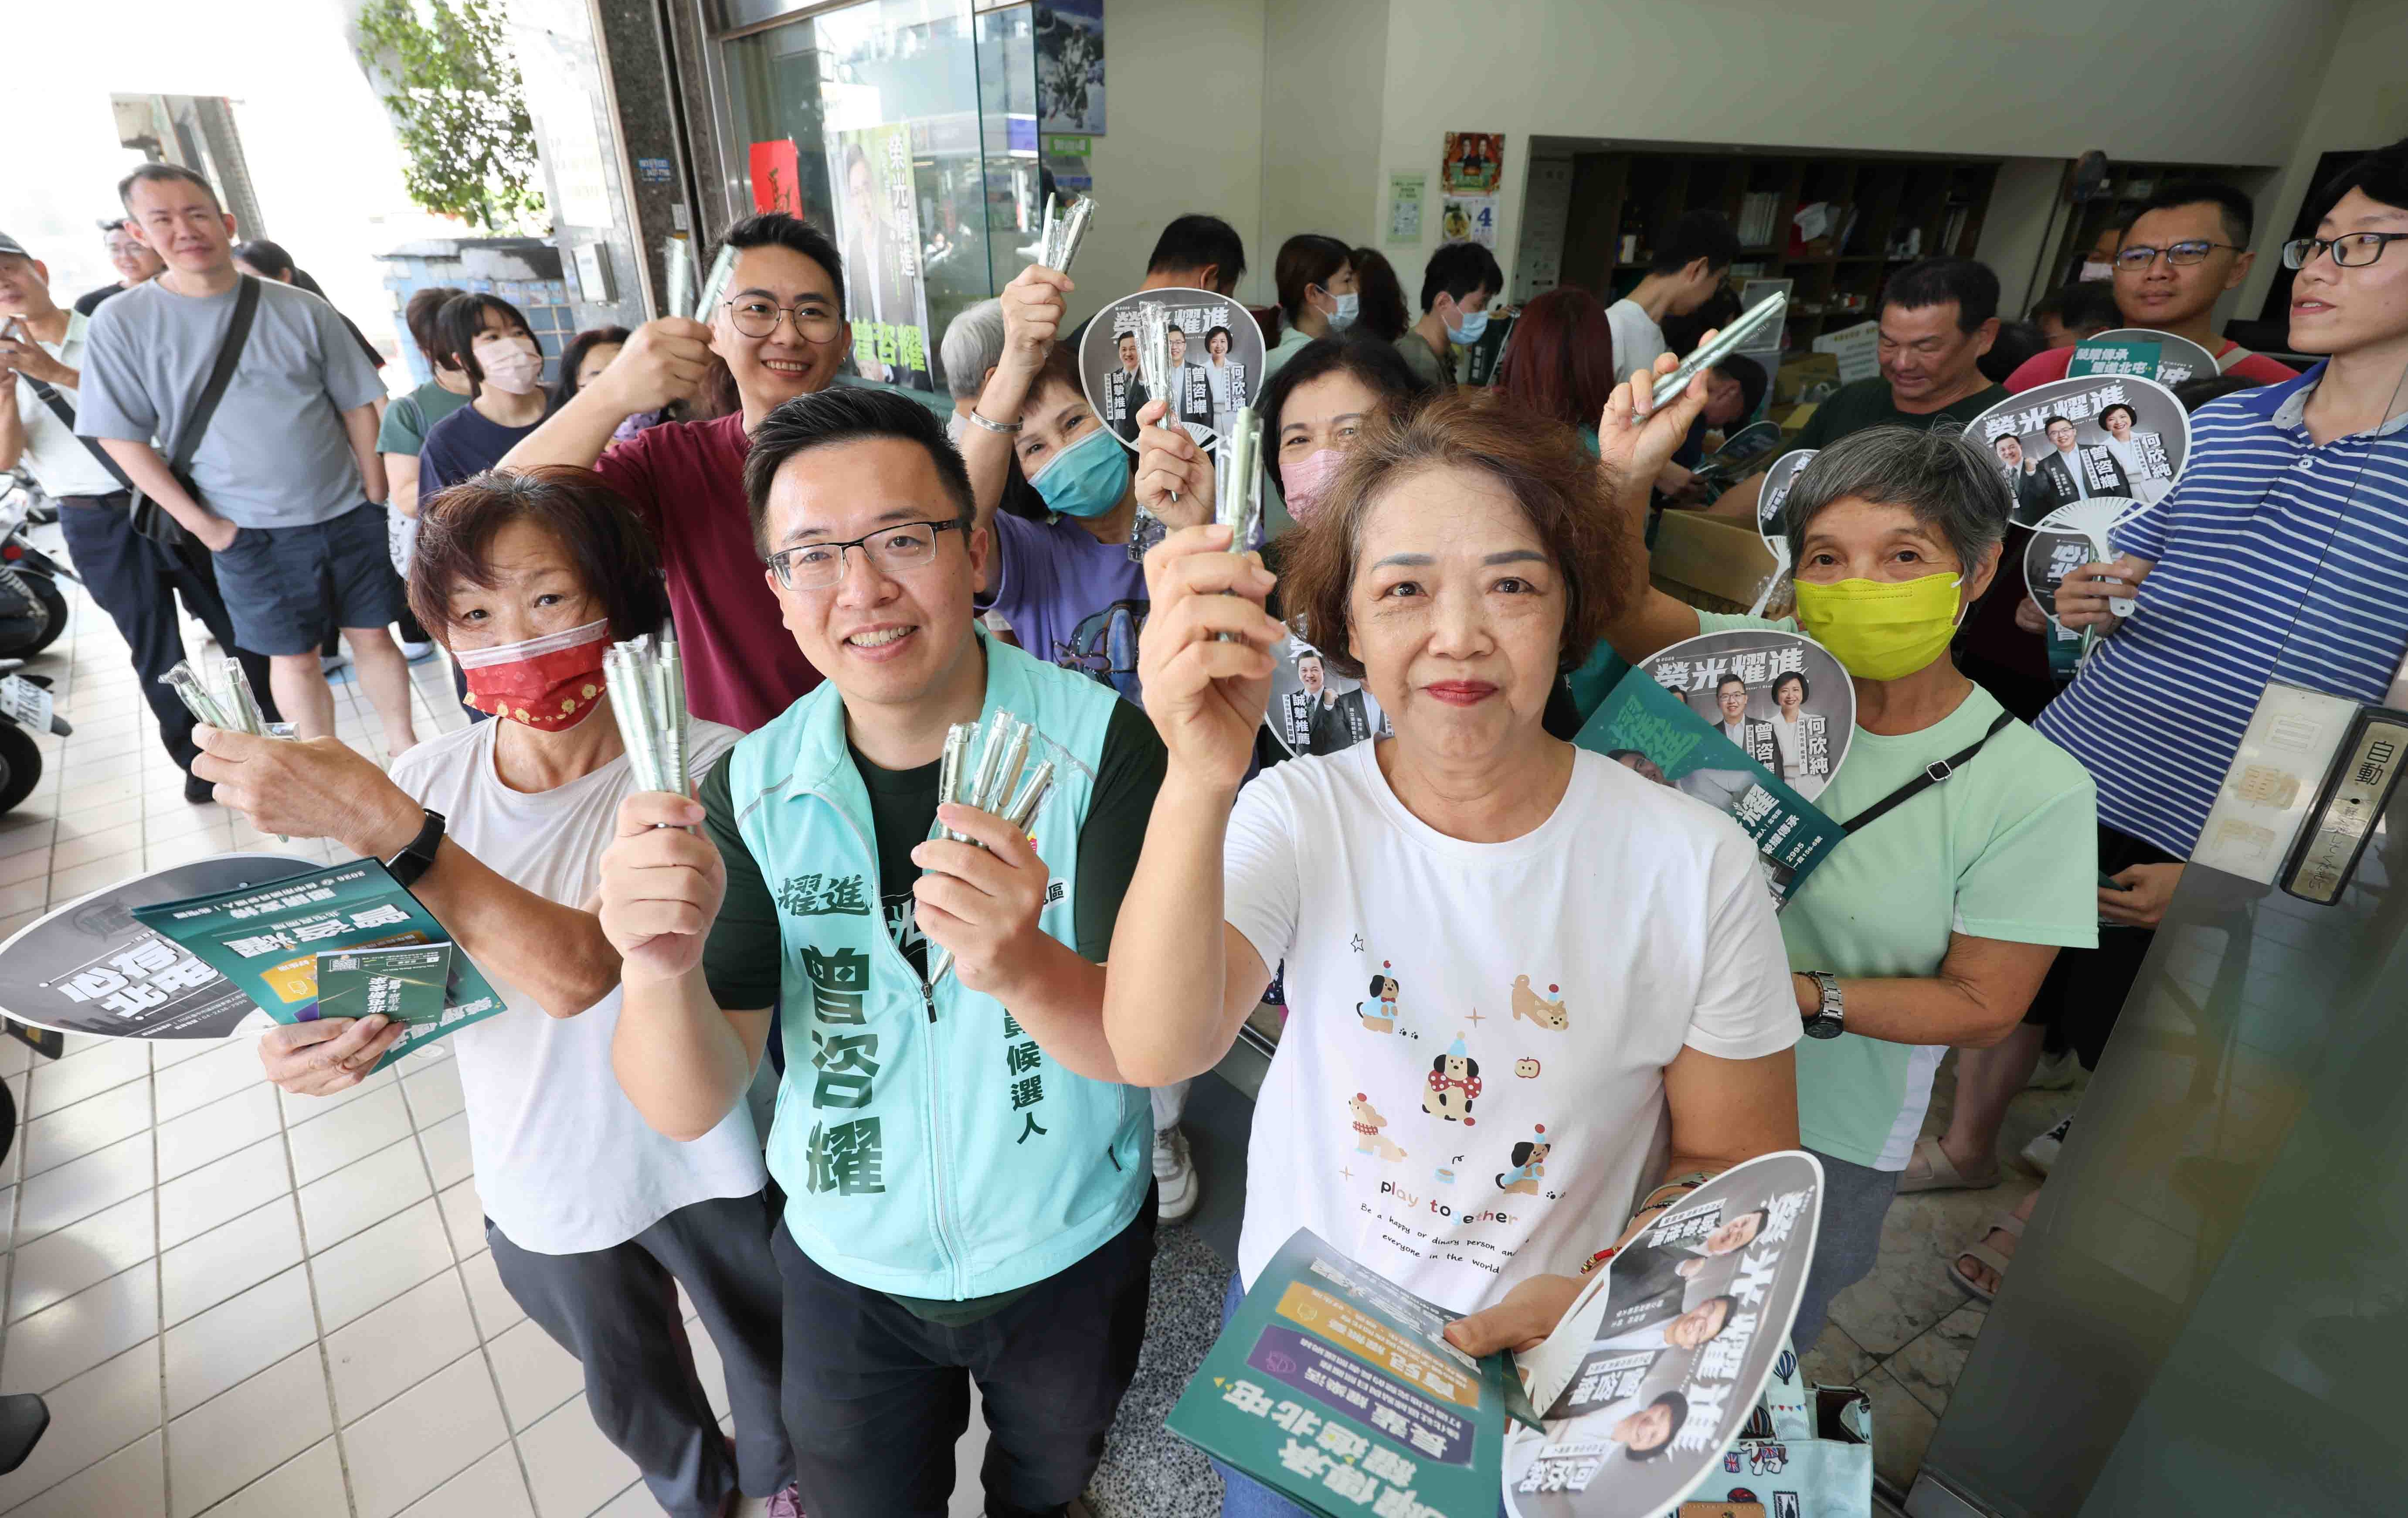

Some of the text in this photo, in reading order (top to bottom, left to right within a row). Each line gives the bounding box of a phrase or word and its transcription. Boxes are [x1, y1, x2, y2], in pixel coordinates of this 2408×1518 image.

[1477, 207, 1492, 227] 4
[852, 318, 926, 372] 曾咨耀
[1111, 306, 1233, 339] 榮耀進
[1112, 372, 1126, 420] 誠摯推薦
[1192, 367, 1207, 415] 曾咨耀
[1231, 365, 1246, 411] 何欣純
[1983, 385, 2133, 444] 榮光耀進
[2090, 446, 2120, 490] 曾咨耀
[2142, 432, 2172, 479] 何欣純
[1654, 647, 1808, 692] 榮光耀進
[1292, 694, 1310, 745] 誠摯推薦
[1807, 717, 1829, 775] 何欣純
[2354, 741, 2395, 786] 自動
[1733, 783, 1780, 827] 耀
[1762, 814, 1800, 854] 榮耀傳承
[1786, 842, 1804, 862] 2995
[1793, 835, 1823, 868] 一段156-6號
[778, 874, 870, 916] 耀進
[222, 903, 411, 958] 曾咨耀
[800, 945, 886, 1197] 曾咨耀
[1380, 1180, 1518, 1225] play together
[1361, 1203, 1372, 1214] Be
[1389, 1216, 1411, 1235] happy
[1417, 1231, 1428, 1239] or
[1432, 1236, 1460, 1247] dinary
[1466, 1238, 1495, 1251] person
[1382, 1233, 1421, 1258] everyone
[1447, 1252, 1464, 1262] the
[1471, 1257, 1500, 1274] world
[1666, 1190, 1806, 1460] 榮光耀進
[1389, 1351, 1457, 1402] 育兒
[1223, 1379, 1417, 1487] 耀進北屯
[1304, 1366, 1447, 1459] 長輩 耀樂活
[1519, 1457, 1600, 1493] 何欣純
